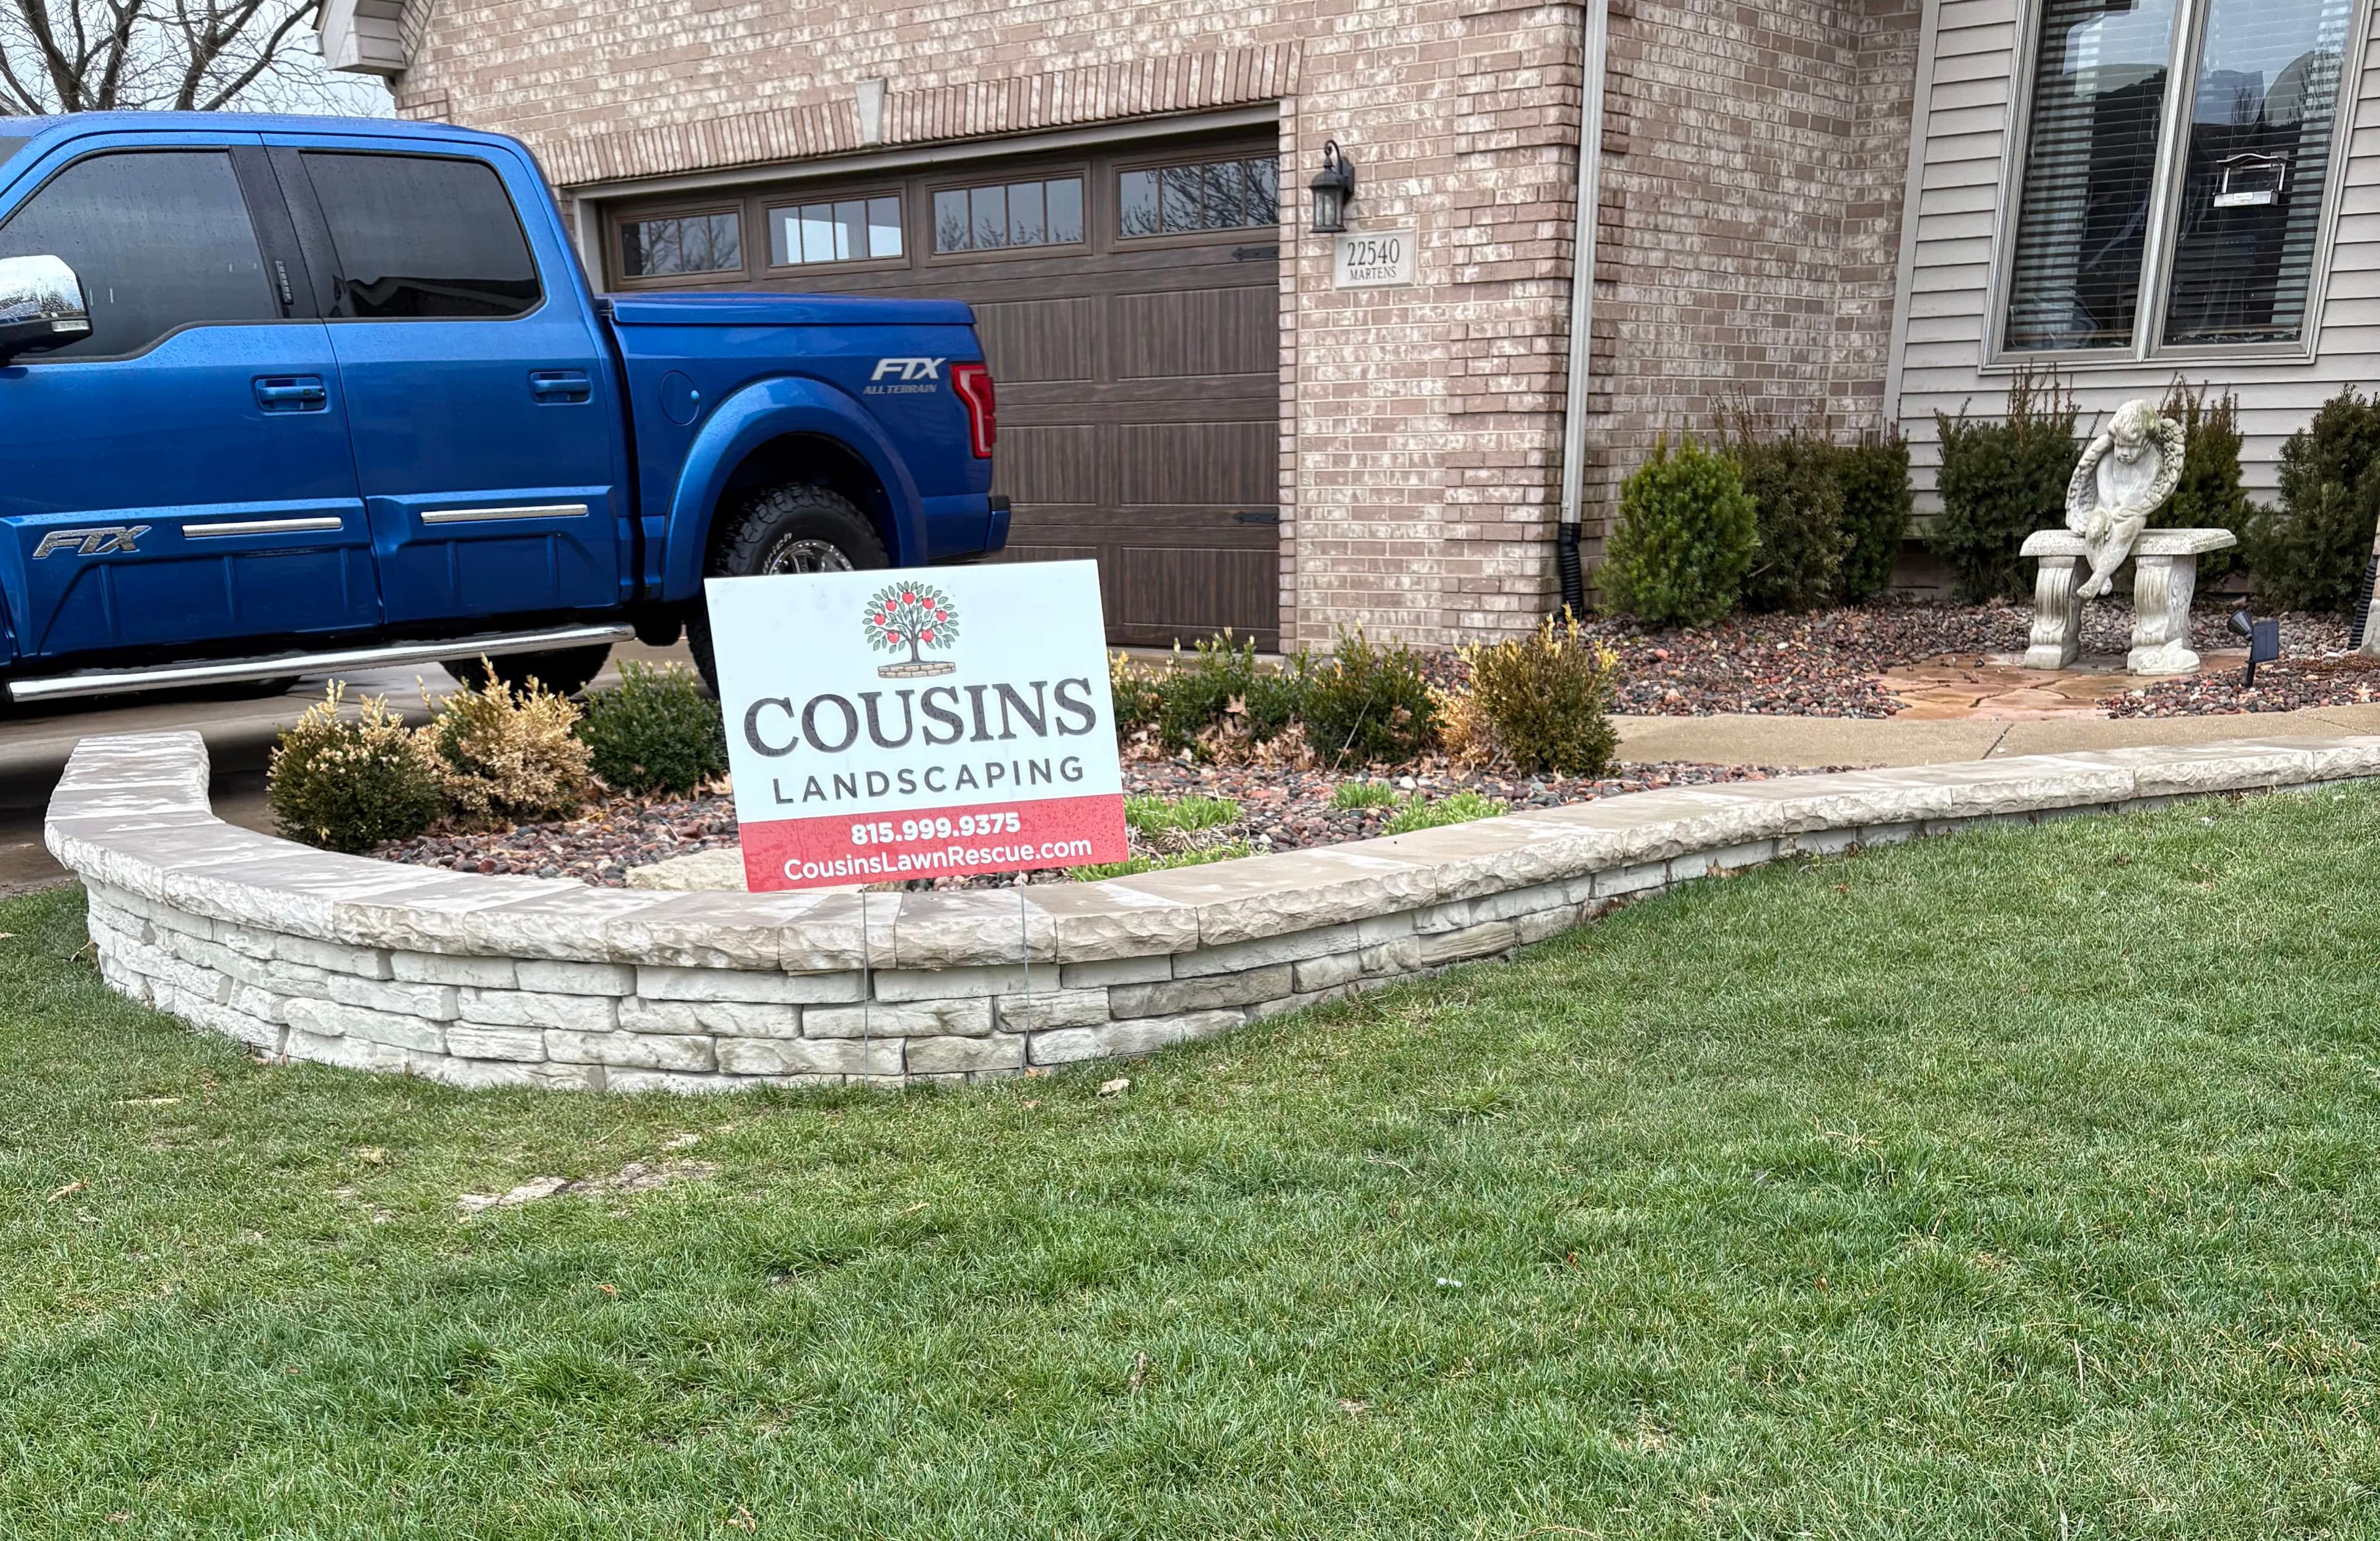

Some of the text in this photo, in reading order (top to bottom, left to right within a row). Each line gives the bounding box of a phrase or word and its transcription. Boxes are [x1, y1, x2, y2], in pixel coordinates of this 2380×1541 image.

[1347, 239, 1400, 266] 22540
[1350, 266, 1397, 281] MARTENS
[870, 358, 946, 380] FTX
[863, 384, 937, 395] ALL TERRAIN
[32, 525, 152, 560] FTX
[744, 678, 1096, 758] COUSINS
[774, 756, 1083, 805] LANDSCAPING
[851, 812, 1021, 845] 815.999.9375
[783, 836, 1092, 880] CousinsLawnRescue.com
